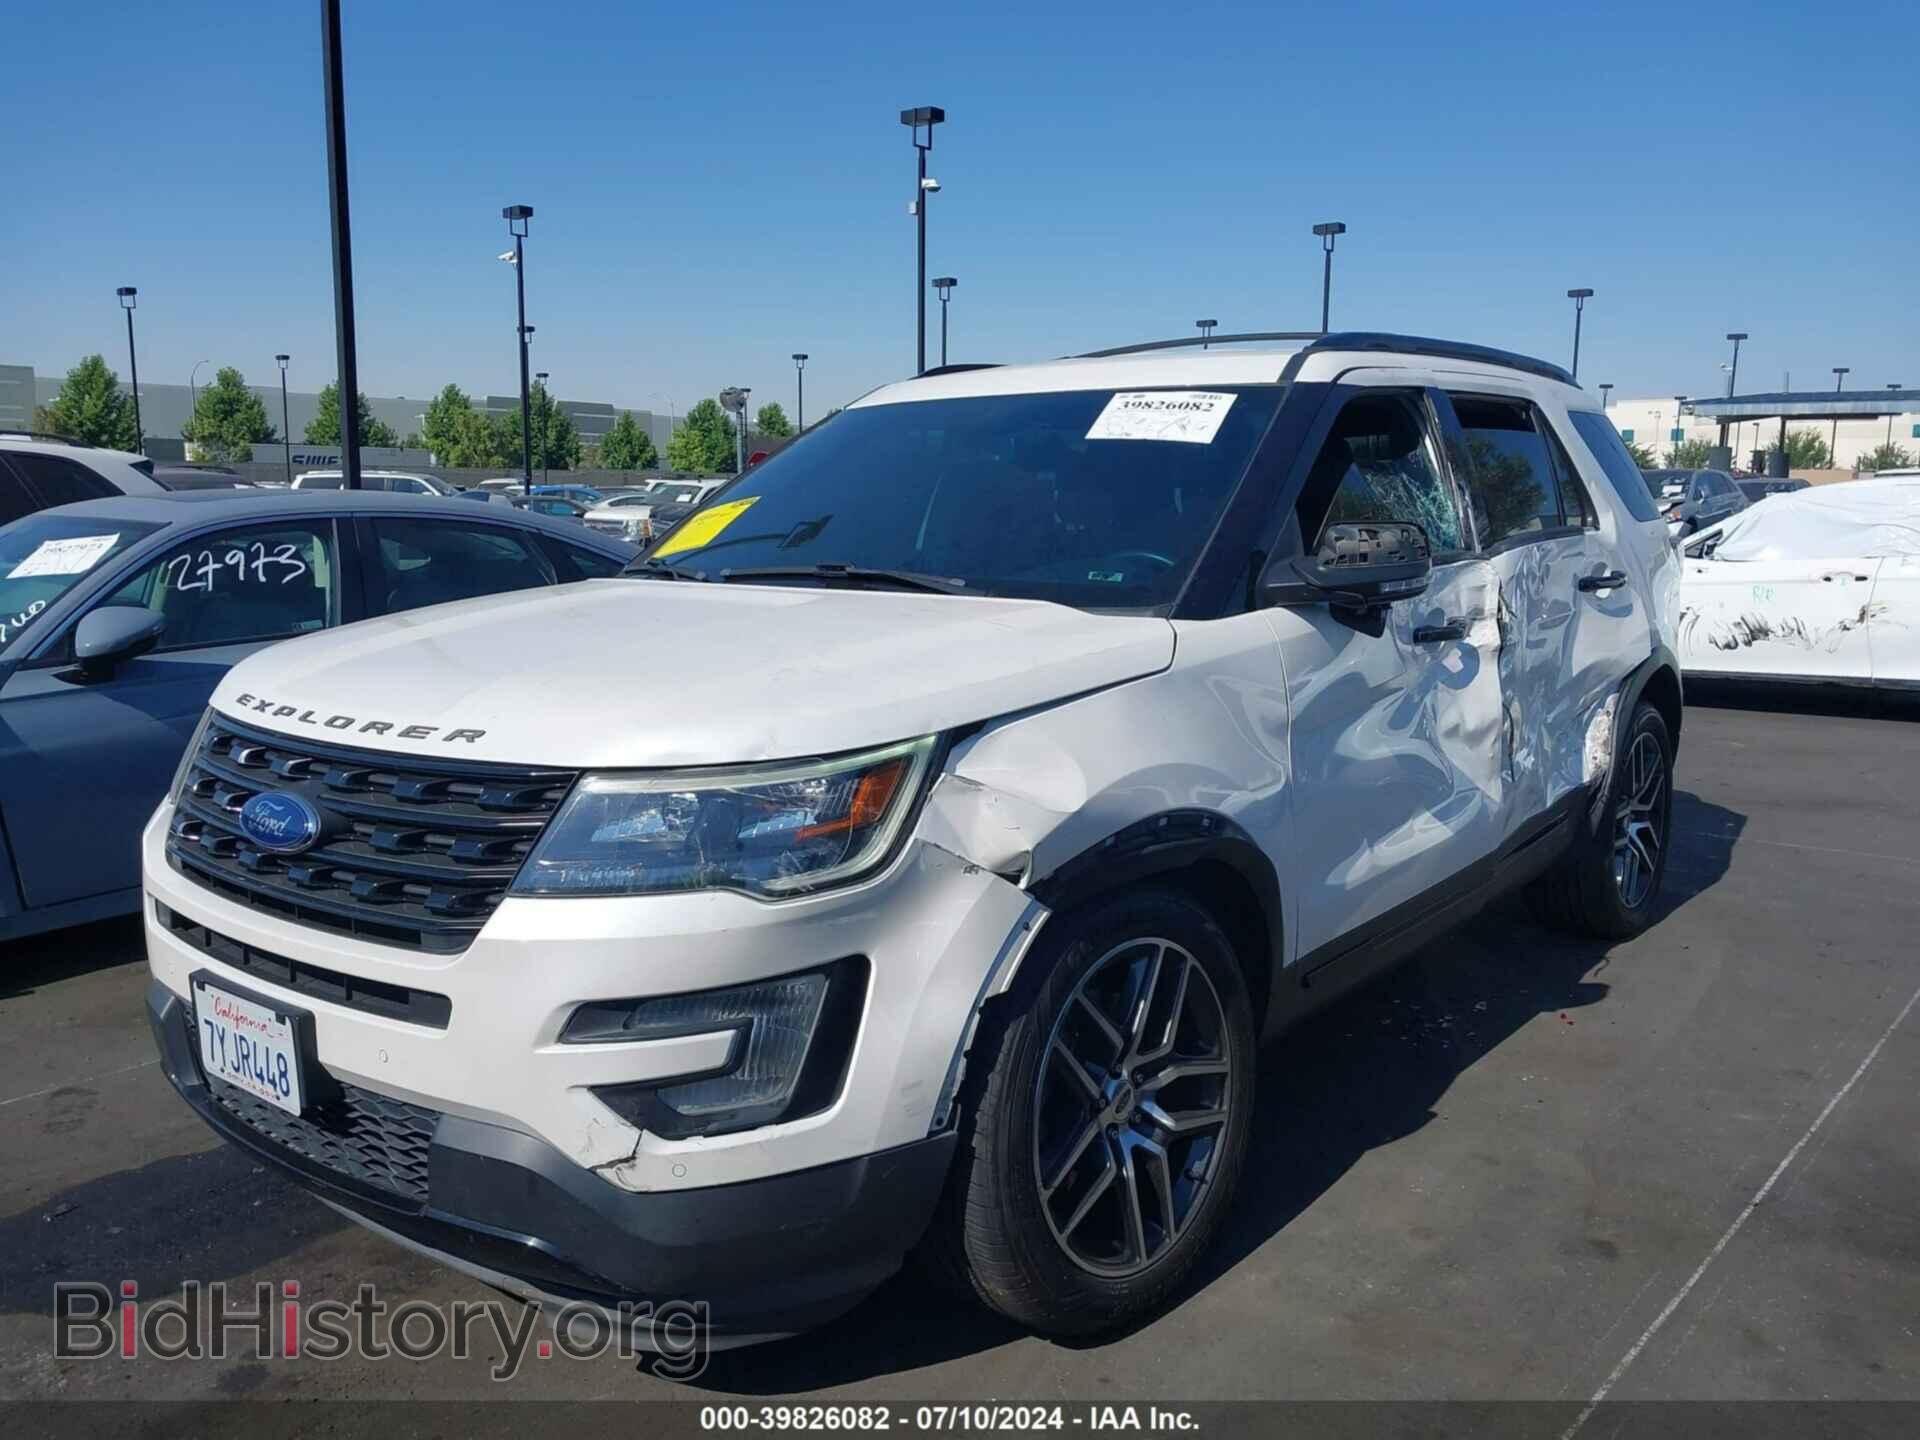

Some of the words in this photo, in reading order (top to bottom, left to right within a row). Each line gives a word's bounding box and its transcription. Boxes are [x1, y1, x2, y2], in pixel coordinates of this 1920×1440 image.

[1118, 401, 1215, 412] 39826082
[168, 542, 306, 592] 27973
[236, 693, 487, 743] EXPLORER
[213, 996, 271, 1033] California
[203, 1018, 291, 1097] 7YJR448
